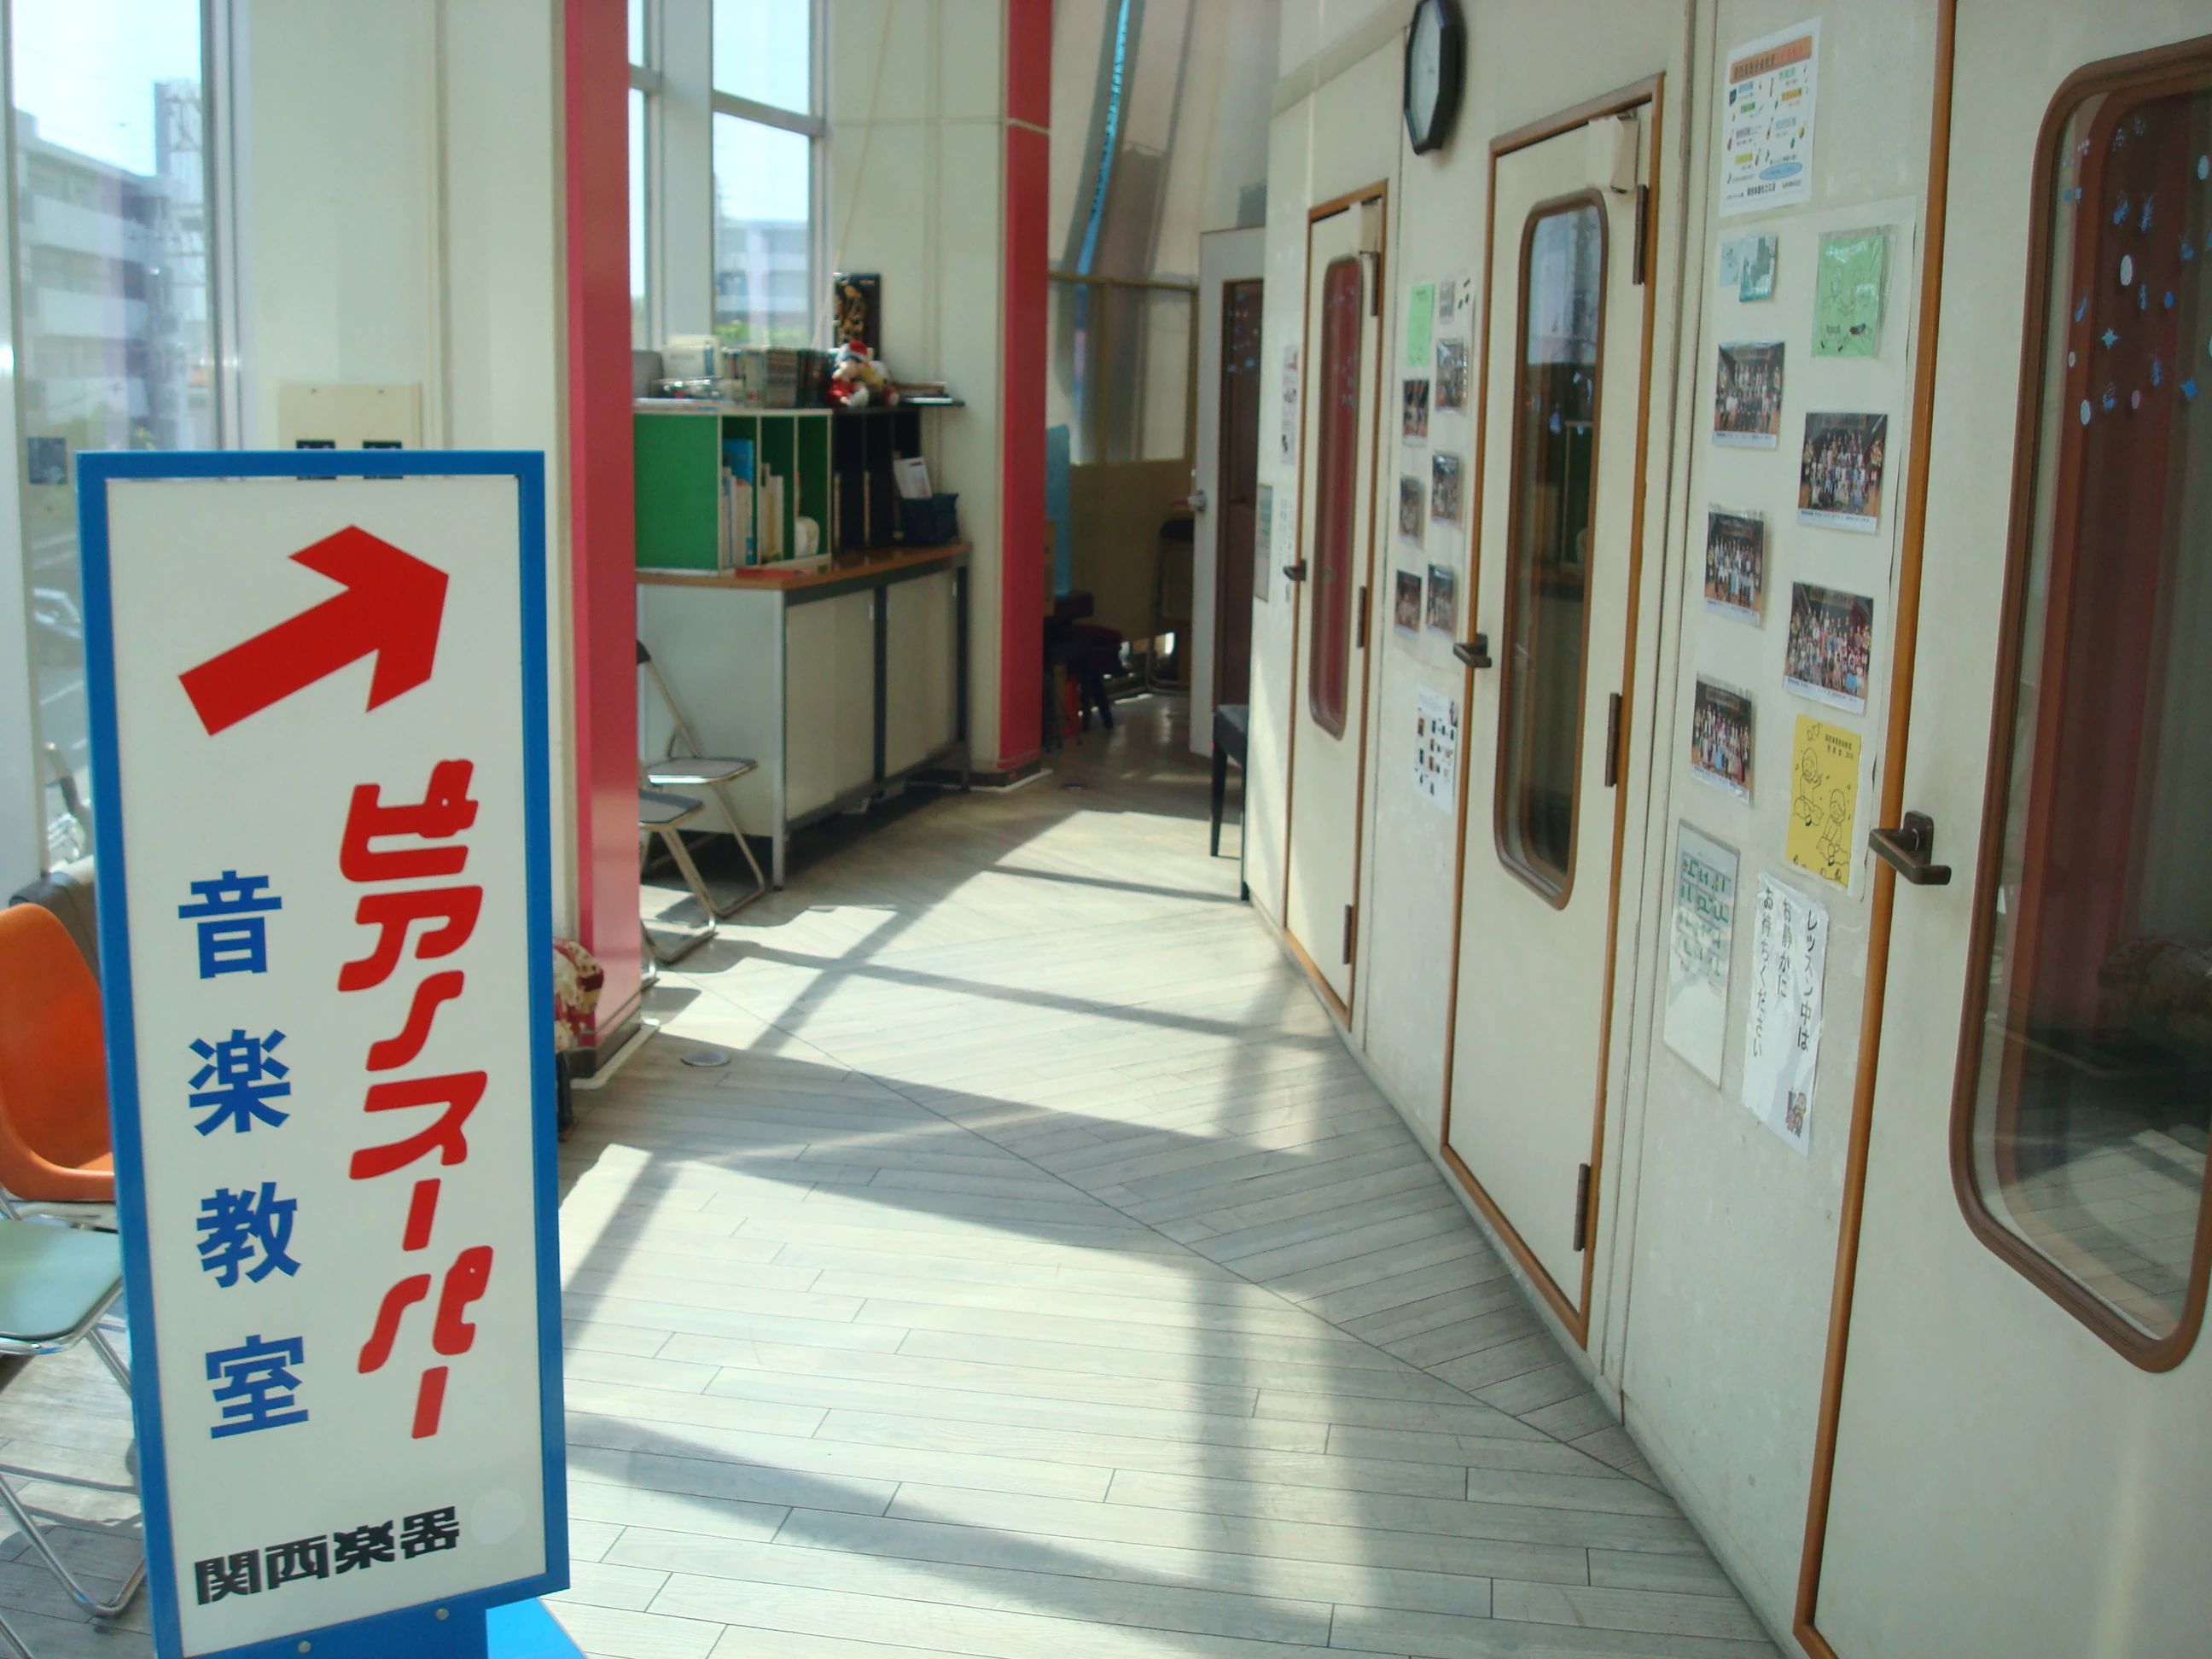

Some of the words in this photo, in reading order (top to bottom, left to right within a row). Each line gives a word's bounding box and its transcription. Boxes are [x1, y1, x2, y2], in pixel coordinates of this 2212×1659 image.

[337, 759, 493, 1440] ピアノスーパー
[1778, 897, 1793, 998] お静かに
[178, 870, 310, 1440] 音楽教室
[194, 1505, 460, 1605] 関西楽器
